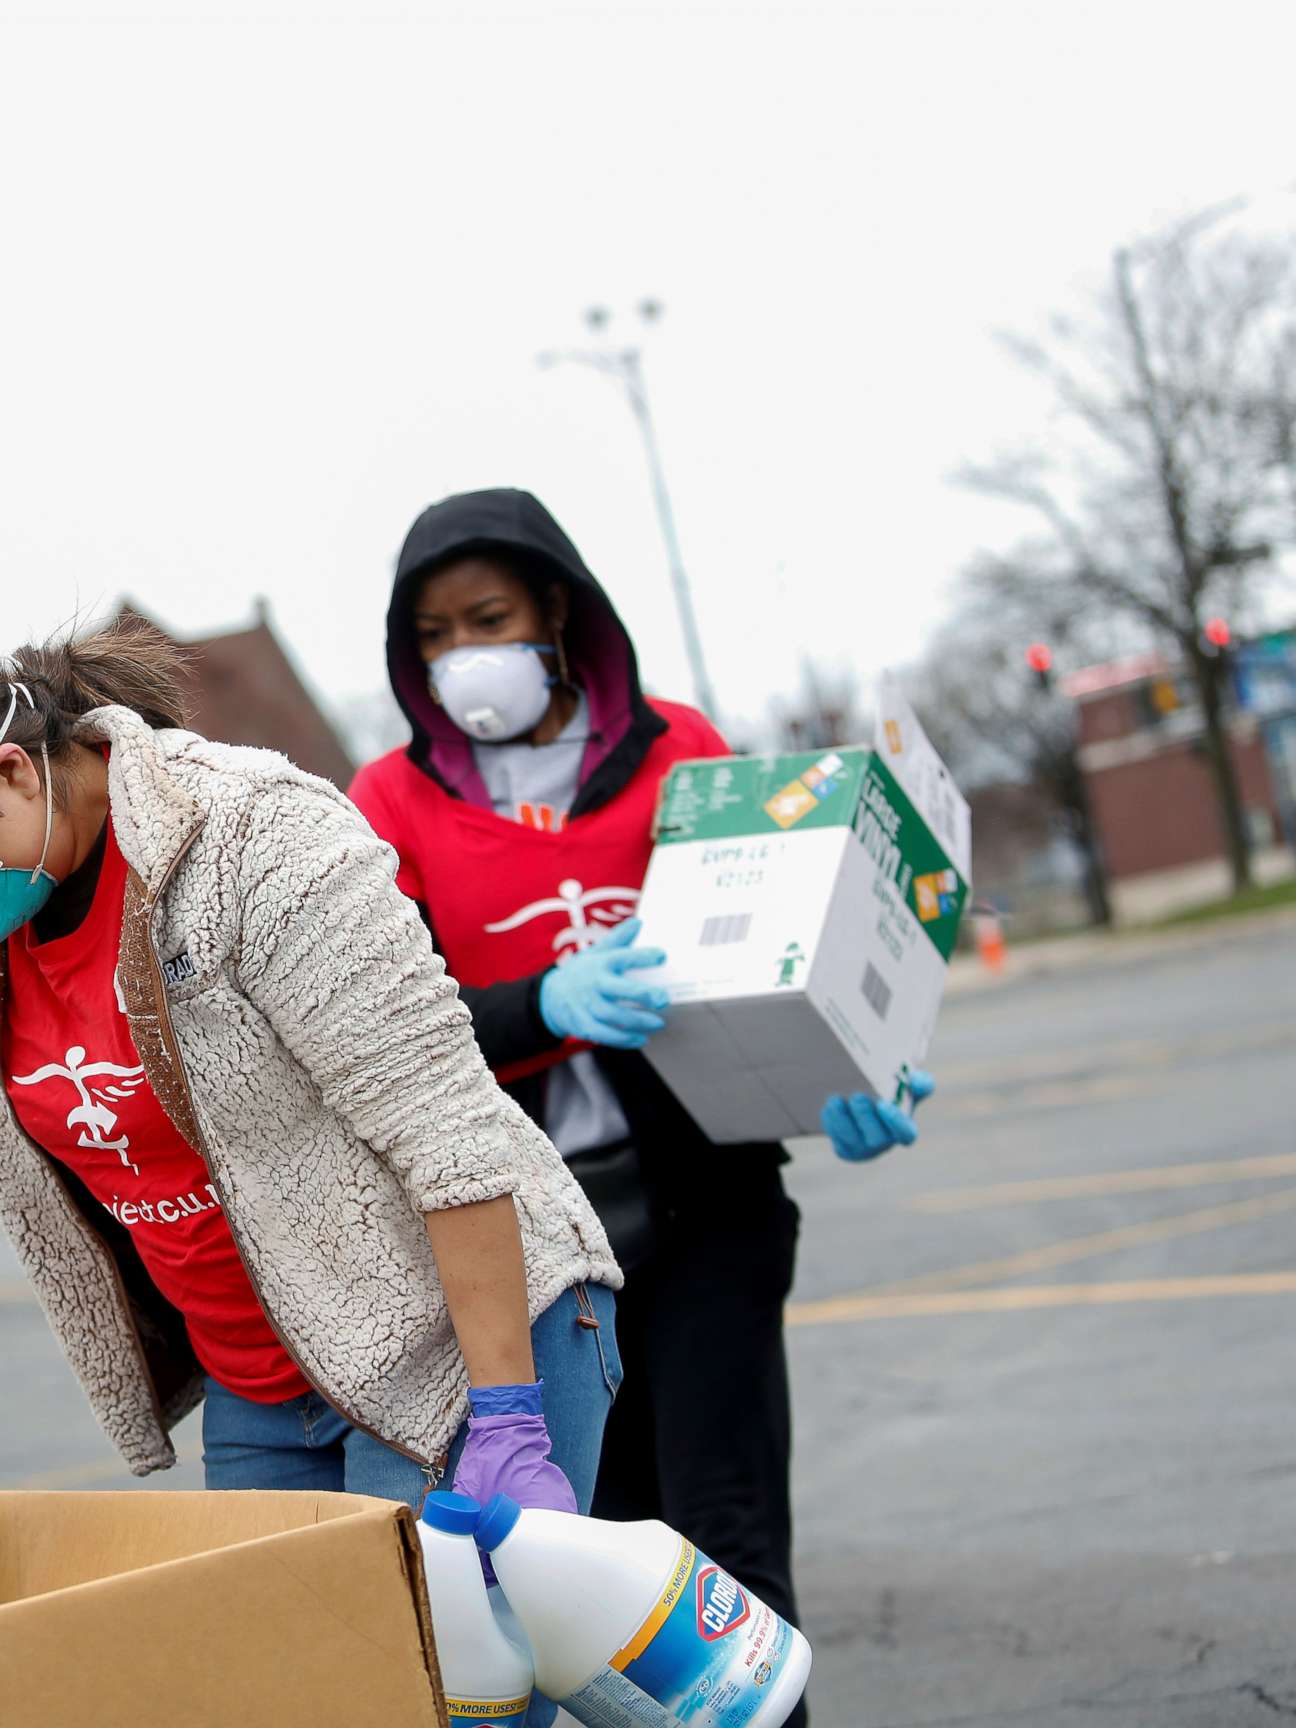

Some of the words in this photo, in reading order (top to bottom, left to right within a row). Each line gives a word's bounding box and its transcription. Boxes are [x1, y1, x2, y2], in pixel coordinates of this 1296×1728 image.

[663, 1586, 679, 1607] 50%
[673, 1563, 689, 1590] MORE
[459, 1703, 493, 1715] MORE
